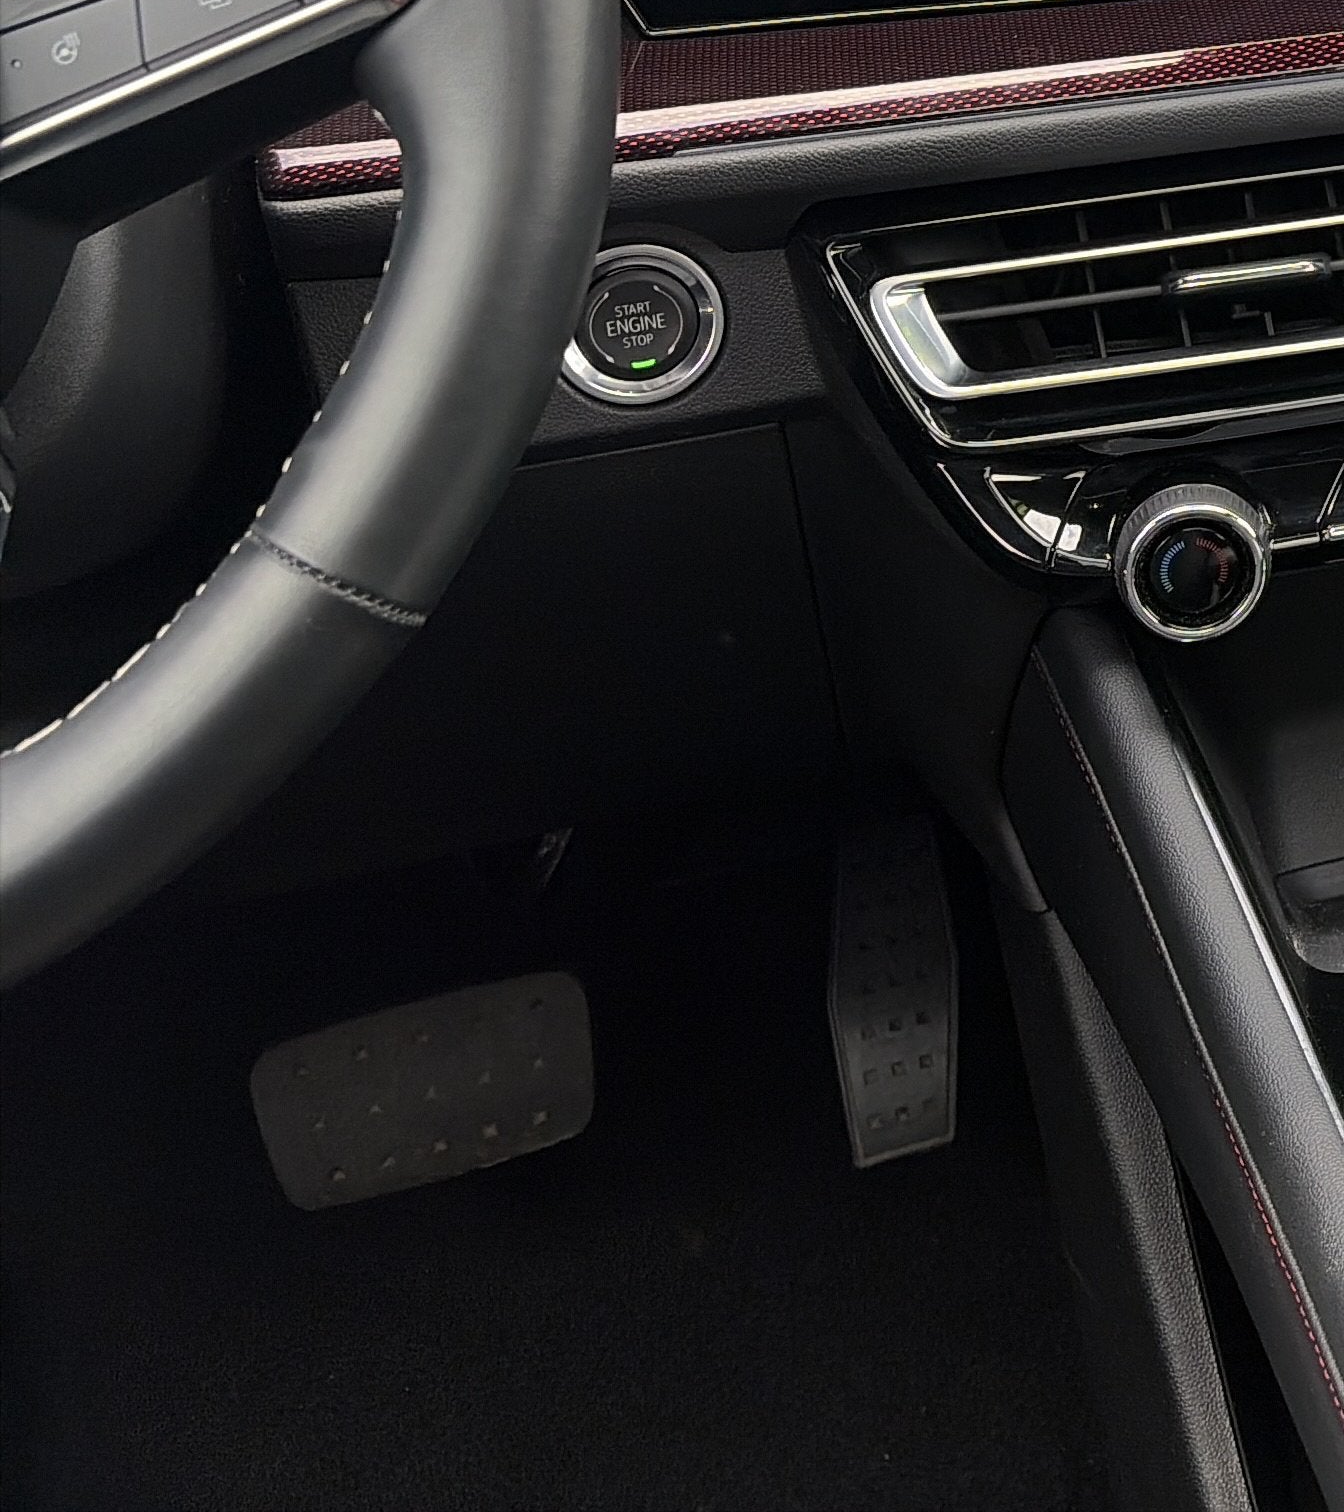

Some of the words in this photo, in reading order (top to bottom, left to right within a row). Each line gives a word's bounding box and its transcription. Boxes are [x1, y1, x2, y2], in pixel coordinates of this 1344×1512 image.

[615, 301, 651, 317] START
[606, 314, 667, 337] ENGINE
[623, 334, 654, 348] STOP
